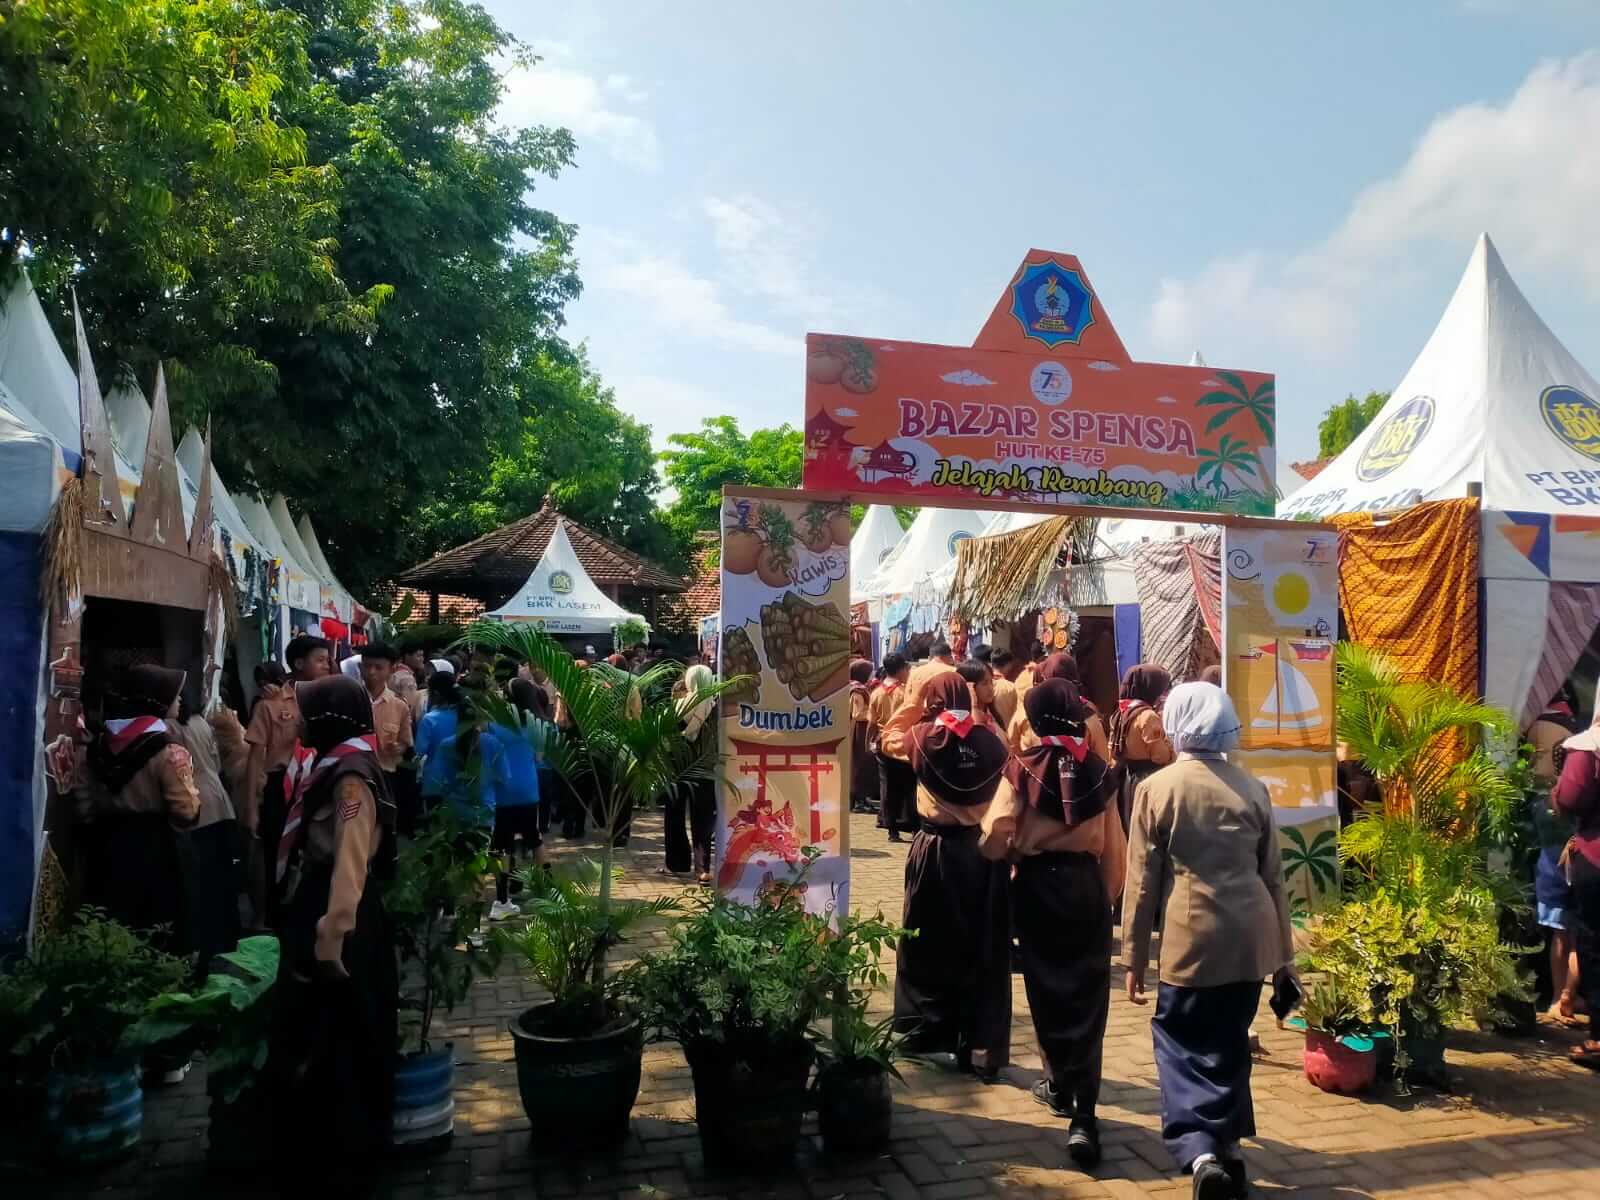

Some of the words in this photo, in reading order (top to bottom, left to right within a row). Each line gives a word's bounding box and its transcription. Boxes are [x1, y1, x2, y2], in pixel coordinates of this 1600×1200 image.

[899, 398, 1039, 438] BAZAR
[1050, 410, 1197, 458] SPENSA
[996, 442, 1039, 459] HUT
[932, 459, 1031, 496] Jelajah
[1040, 464, 1167, 504] Rembang
[1526, 471, 1560, 486] PT
[1545, 487, 1600, 505] BK
[789, 554, 838, 587] Kawis
[527, 600, 553, 608] BKK
[558, 601, 601, 610] LASEM
[739, 703, 833, 731] Dumbek
